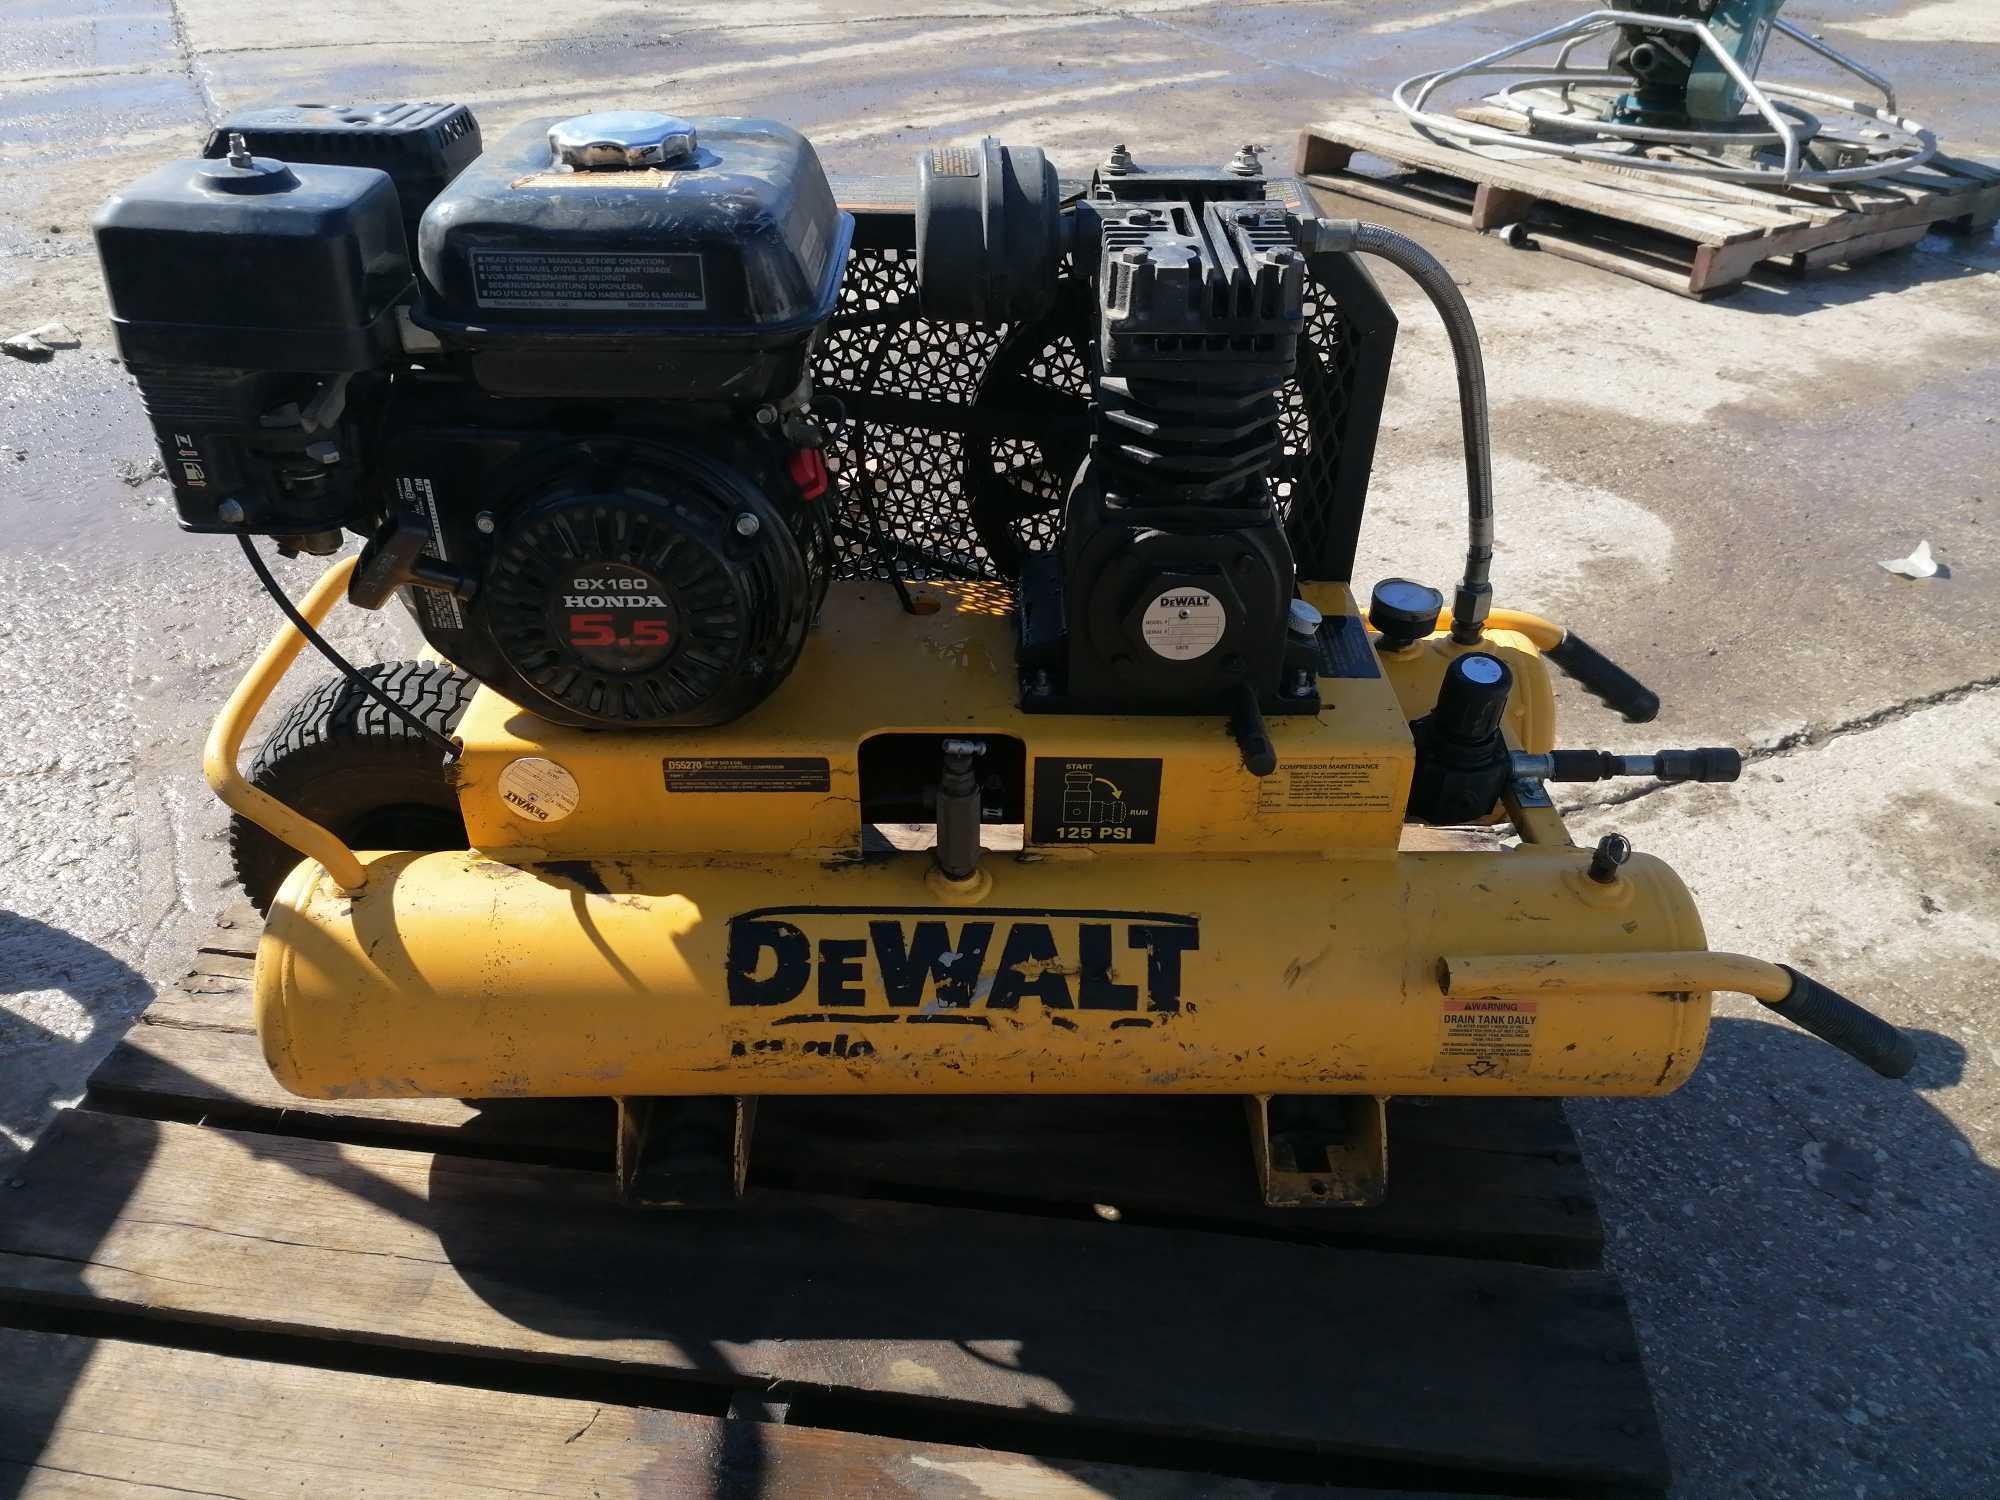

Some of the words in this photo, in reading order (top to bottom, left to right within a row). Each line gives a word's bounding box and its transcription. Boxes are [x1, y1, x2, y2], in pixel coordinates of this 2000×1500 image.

[573, 578, 648, 590] GX160
[562, 595, 667, 608] HONDA
[569, 613, 670, 647] 5.5
[668, 761, 702, 770] D55270
[1056, 827, 1093, 839] 125
[1099, 827, 1132, 840] PSI
[1471, 1002, 1518, 1012] WARNING
[1443, 1014, 1475, 1024] DRAIN
[1476, 1015, 1505, 1025] TANK
[1507, 1015, 1537, 1025] DAILY
